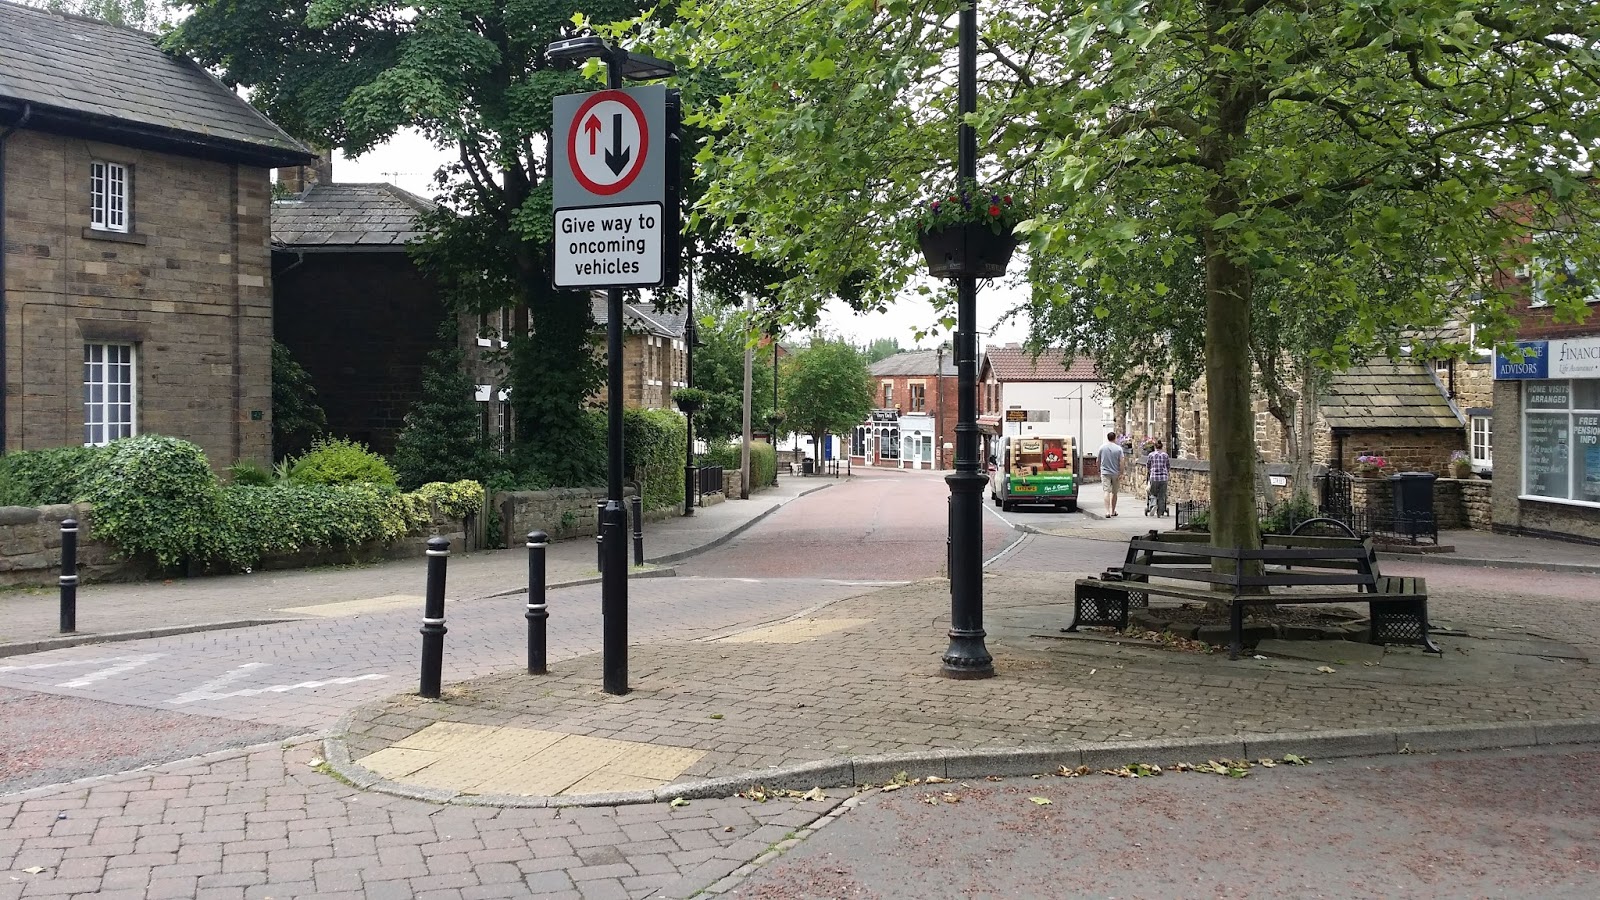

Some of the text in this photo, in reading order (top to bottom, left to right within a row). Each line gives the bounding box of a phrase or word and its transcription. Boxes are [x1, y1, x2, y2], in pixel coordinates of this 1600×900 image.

[561, 213, 655, 234] Give way to
[569, 236, 646, 254] oncoming
[575, 258, 640, 276] vehicles
[1500, 363, 1537, 374] ADVISORS
[1528, 385, 1569, 393] HOME VISITS
[1531, 395, 1567, 403] ARRANGED
[1579, 417, 1598, 425] FREE
[1580, 435, 1597, 444] INFO
